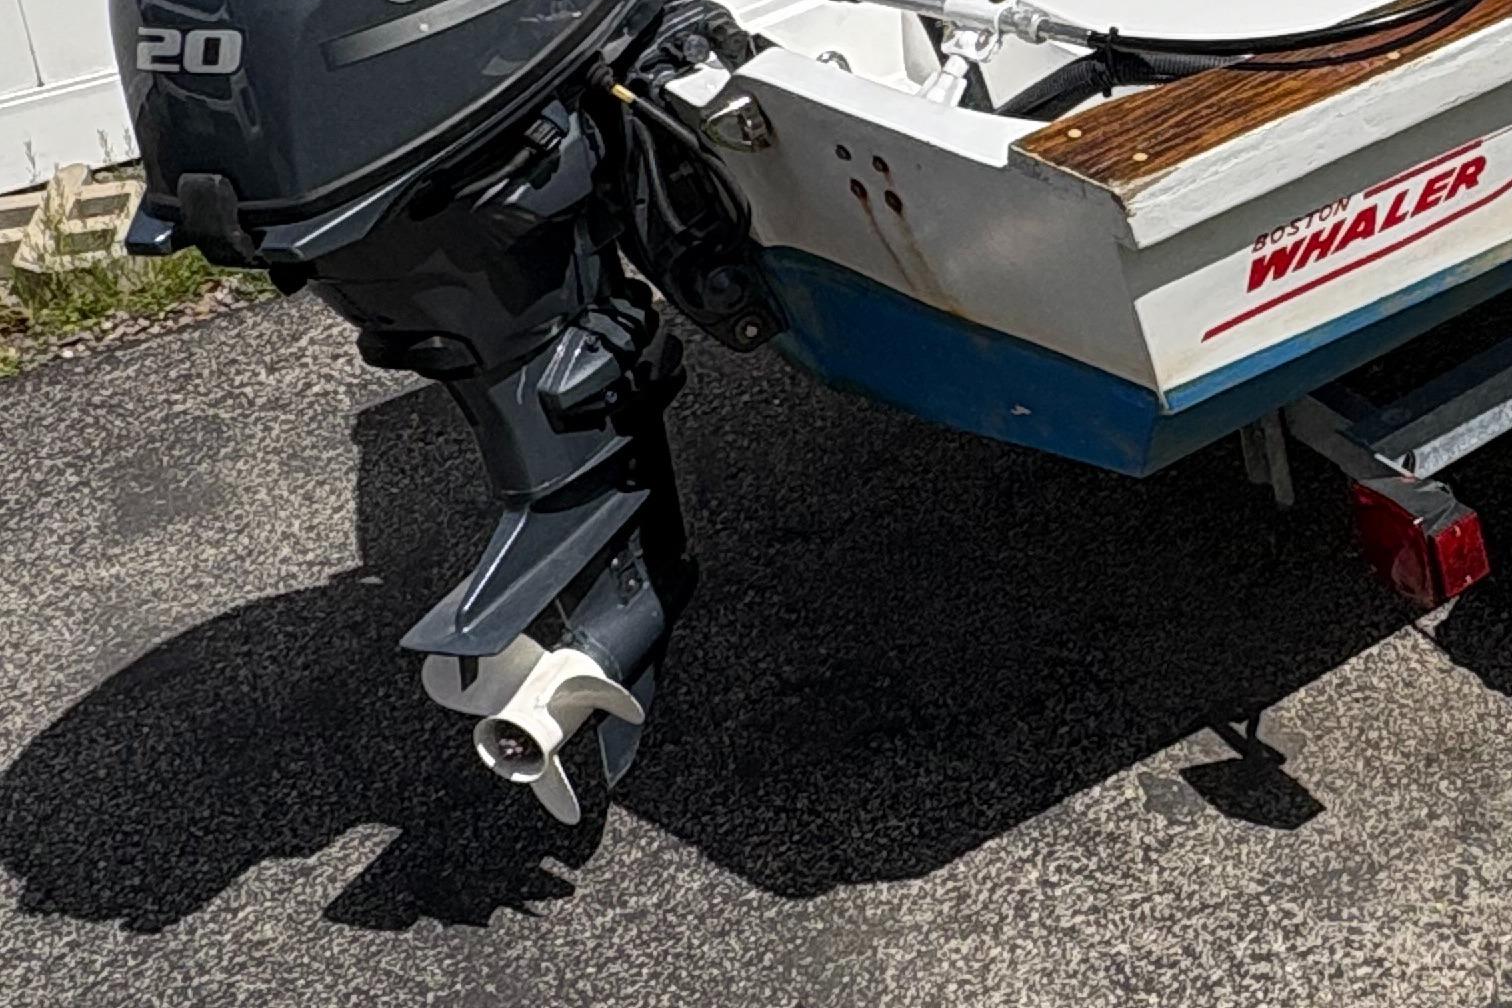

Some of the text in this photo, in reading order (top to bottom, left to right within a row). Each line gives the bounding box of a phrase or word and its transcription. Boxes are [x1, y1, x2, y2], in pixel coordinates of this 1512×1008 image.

[137, 26, 243, 73] 20
[1247, 155, 1486, 293] WHALER
[1252, 195, 1351, 252] BOSTON
